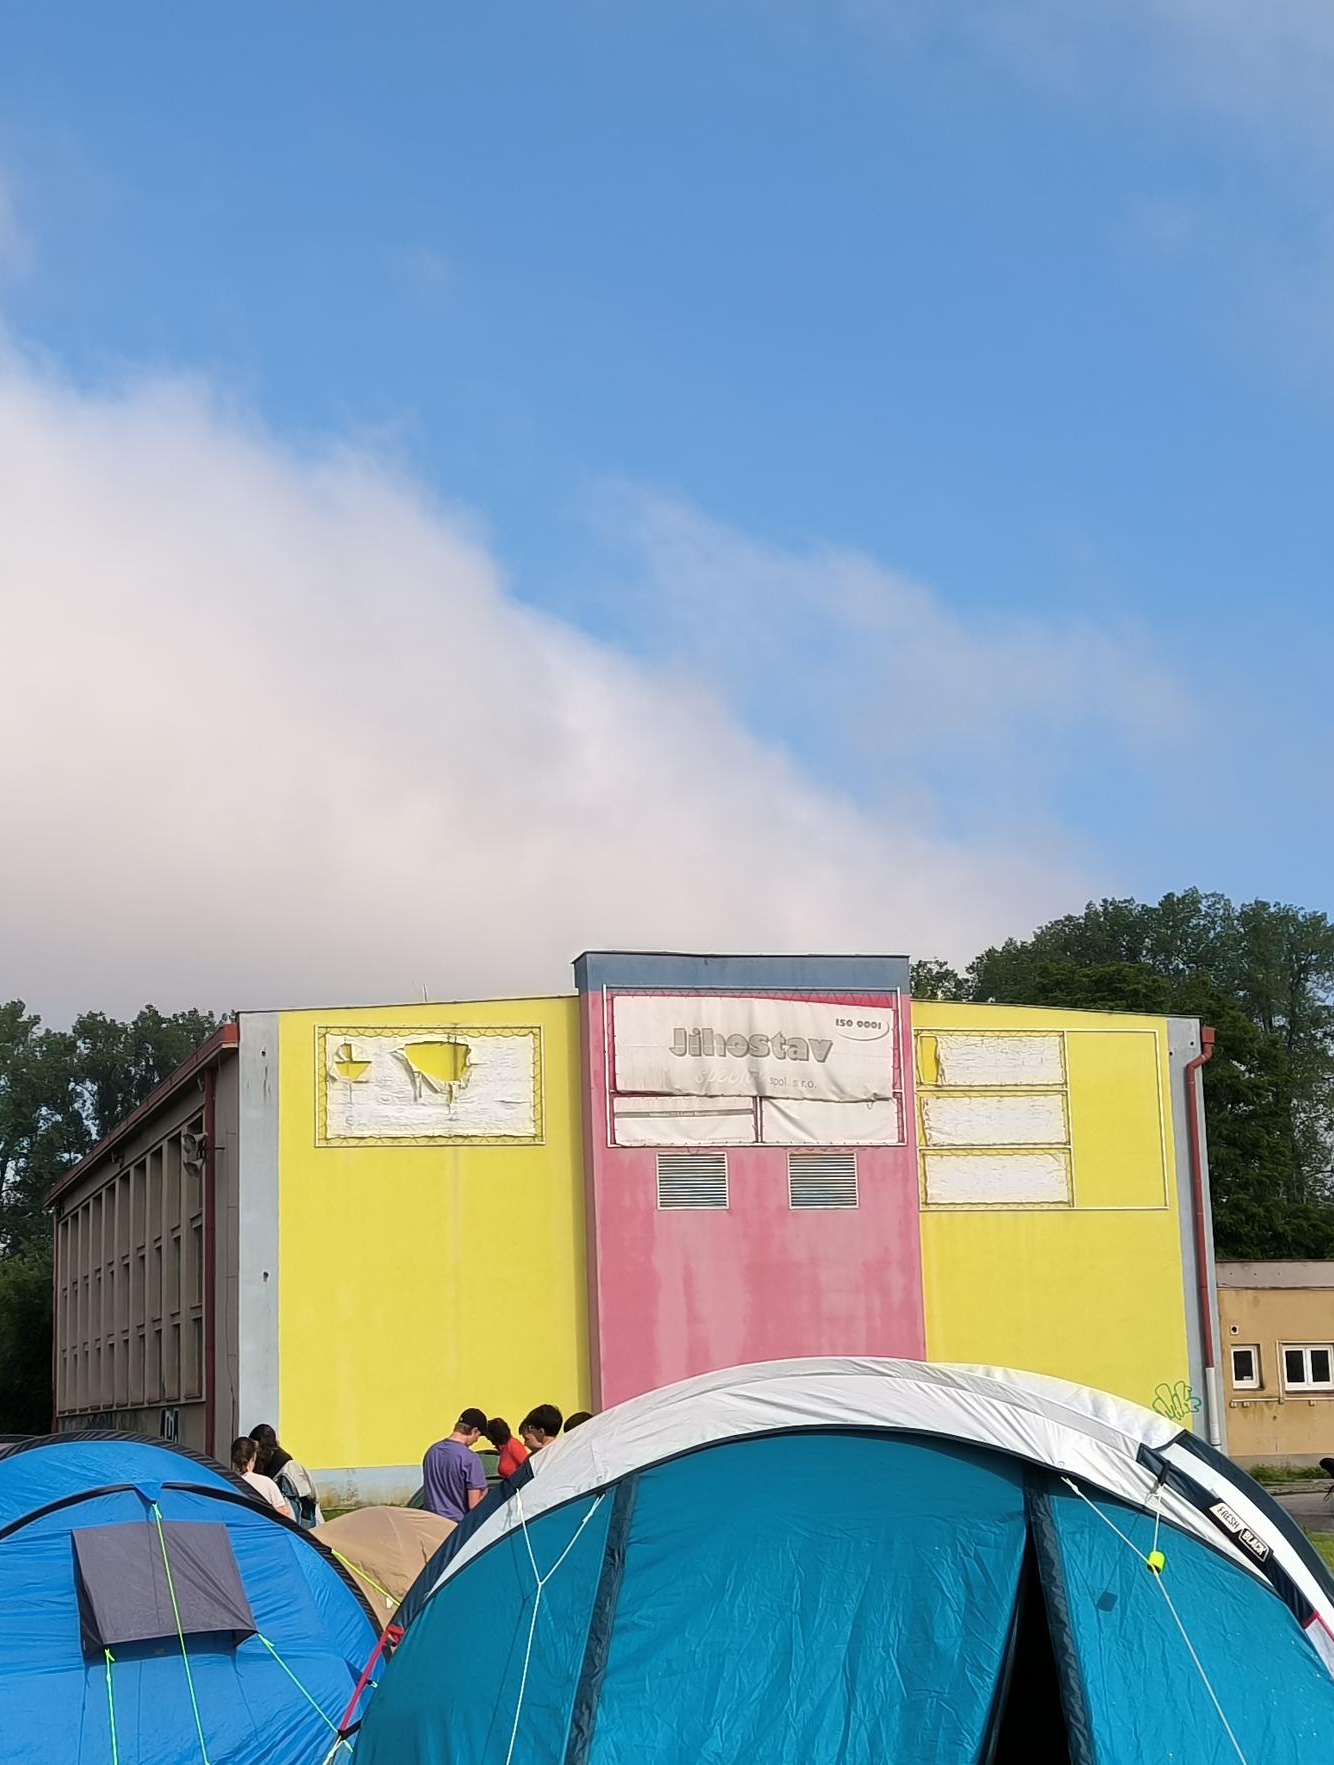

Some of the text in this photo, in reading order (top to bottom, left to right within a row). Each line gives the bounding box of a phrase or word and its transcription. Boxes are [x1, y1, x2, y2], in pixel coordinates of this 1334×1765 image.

[835, 1018, 853, 1027] ISO
[669, 1028, 833, 1063] Jihostav
[1217, 1506, 1267, 1555] FRESH BLACK
